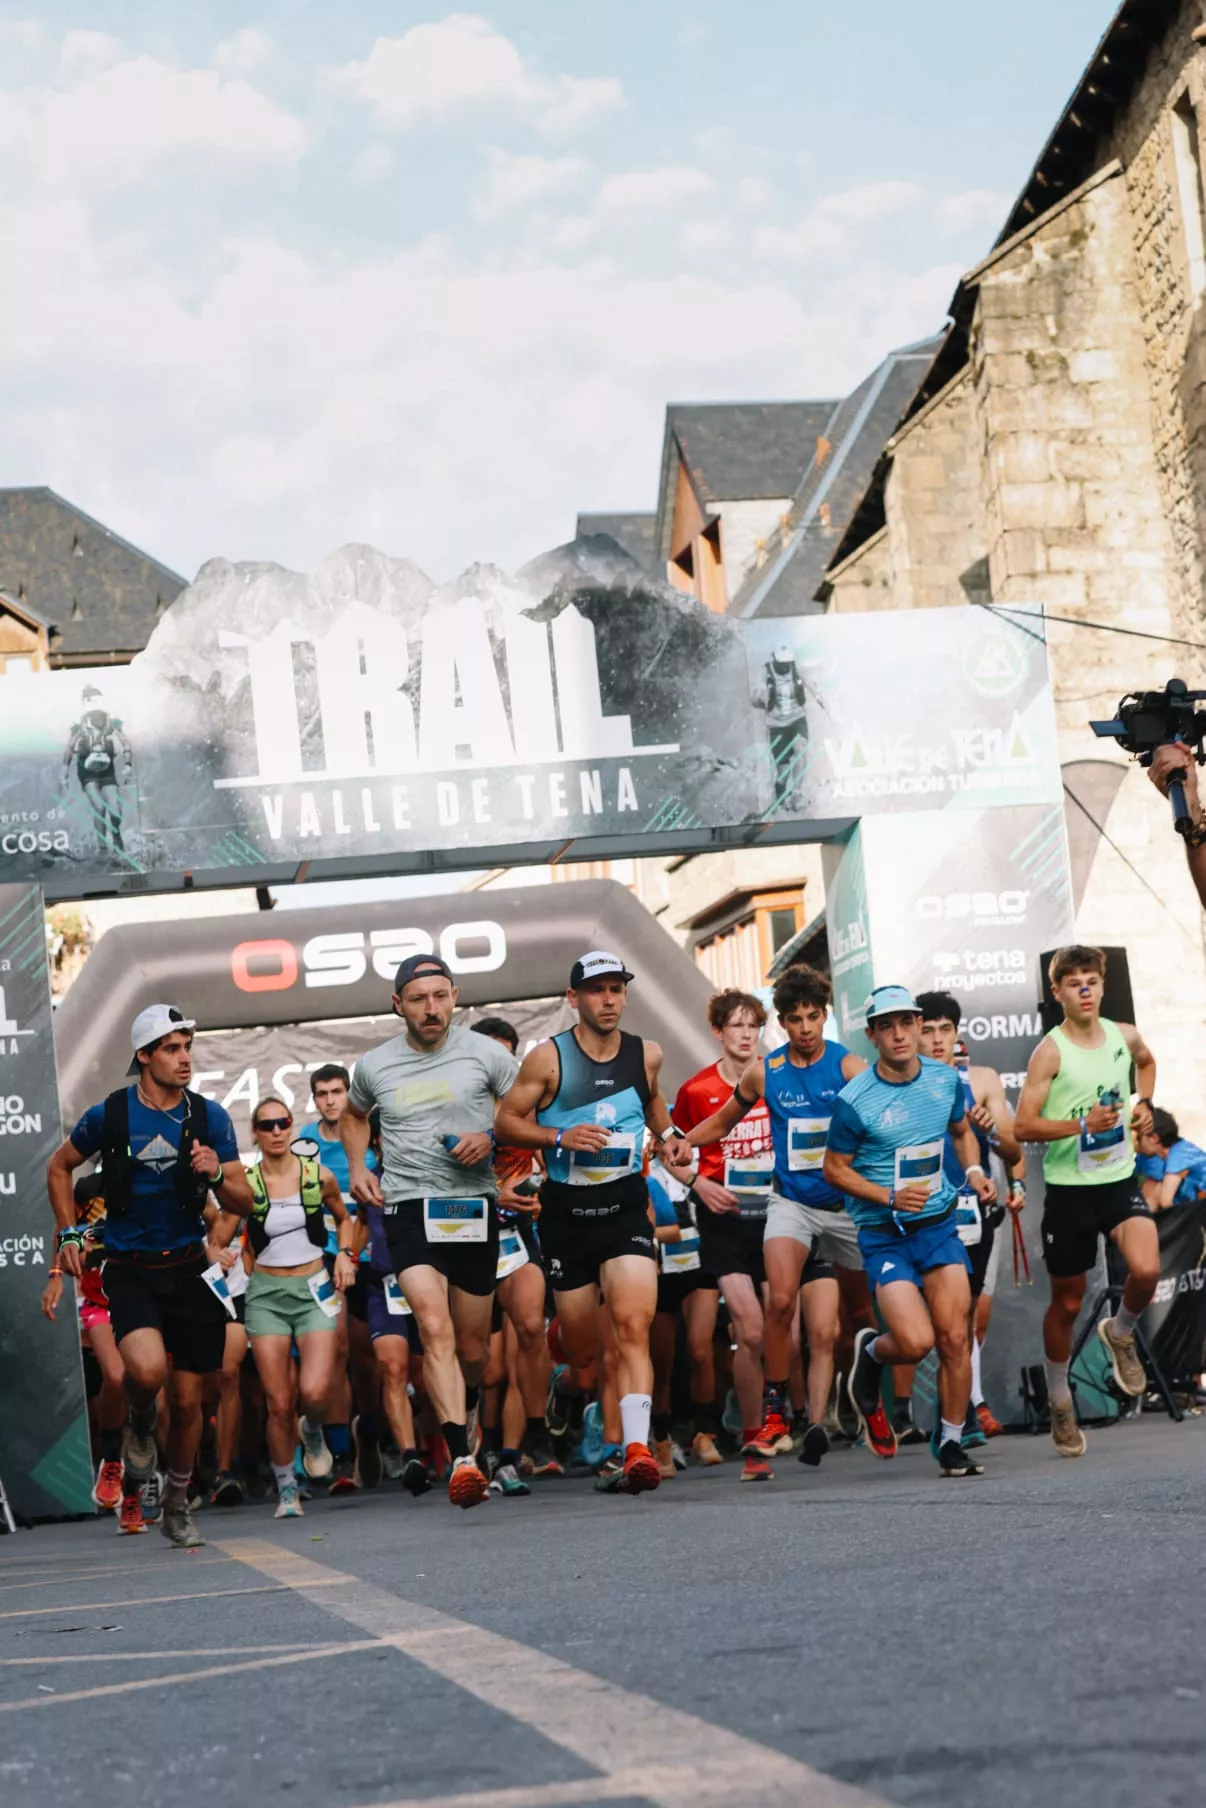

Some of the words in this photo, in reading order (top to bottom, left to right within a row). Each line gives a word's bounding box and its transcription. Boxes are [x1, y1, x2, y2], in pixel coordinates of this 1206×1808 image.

[218, 600, 634, 778] TRAIL
[263, 782, 410, 840] VALLE
[437, 775, 492, 827] DE
[516, 767, 640, 820] TENA
[1, 829, 69, 854] cosa
[962, 949, 1026, 971] tena
[934, 970, 1027, 992] proyectos
